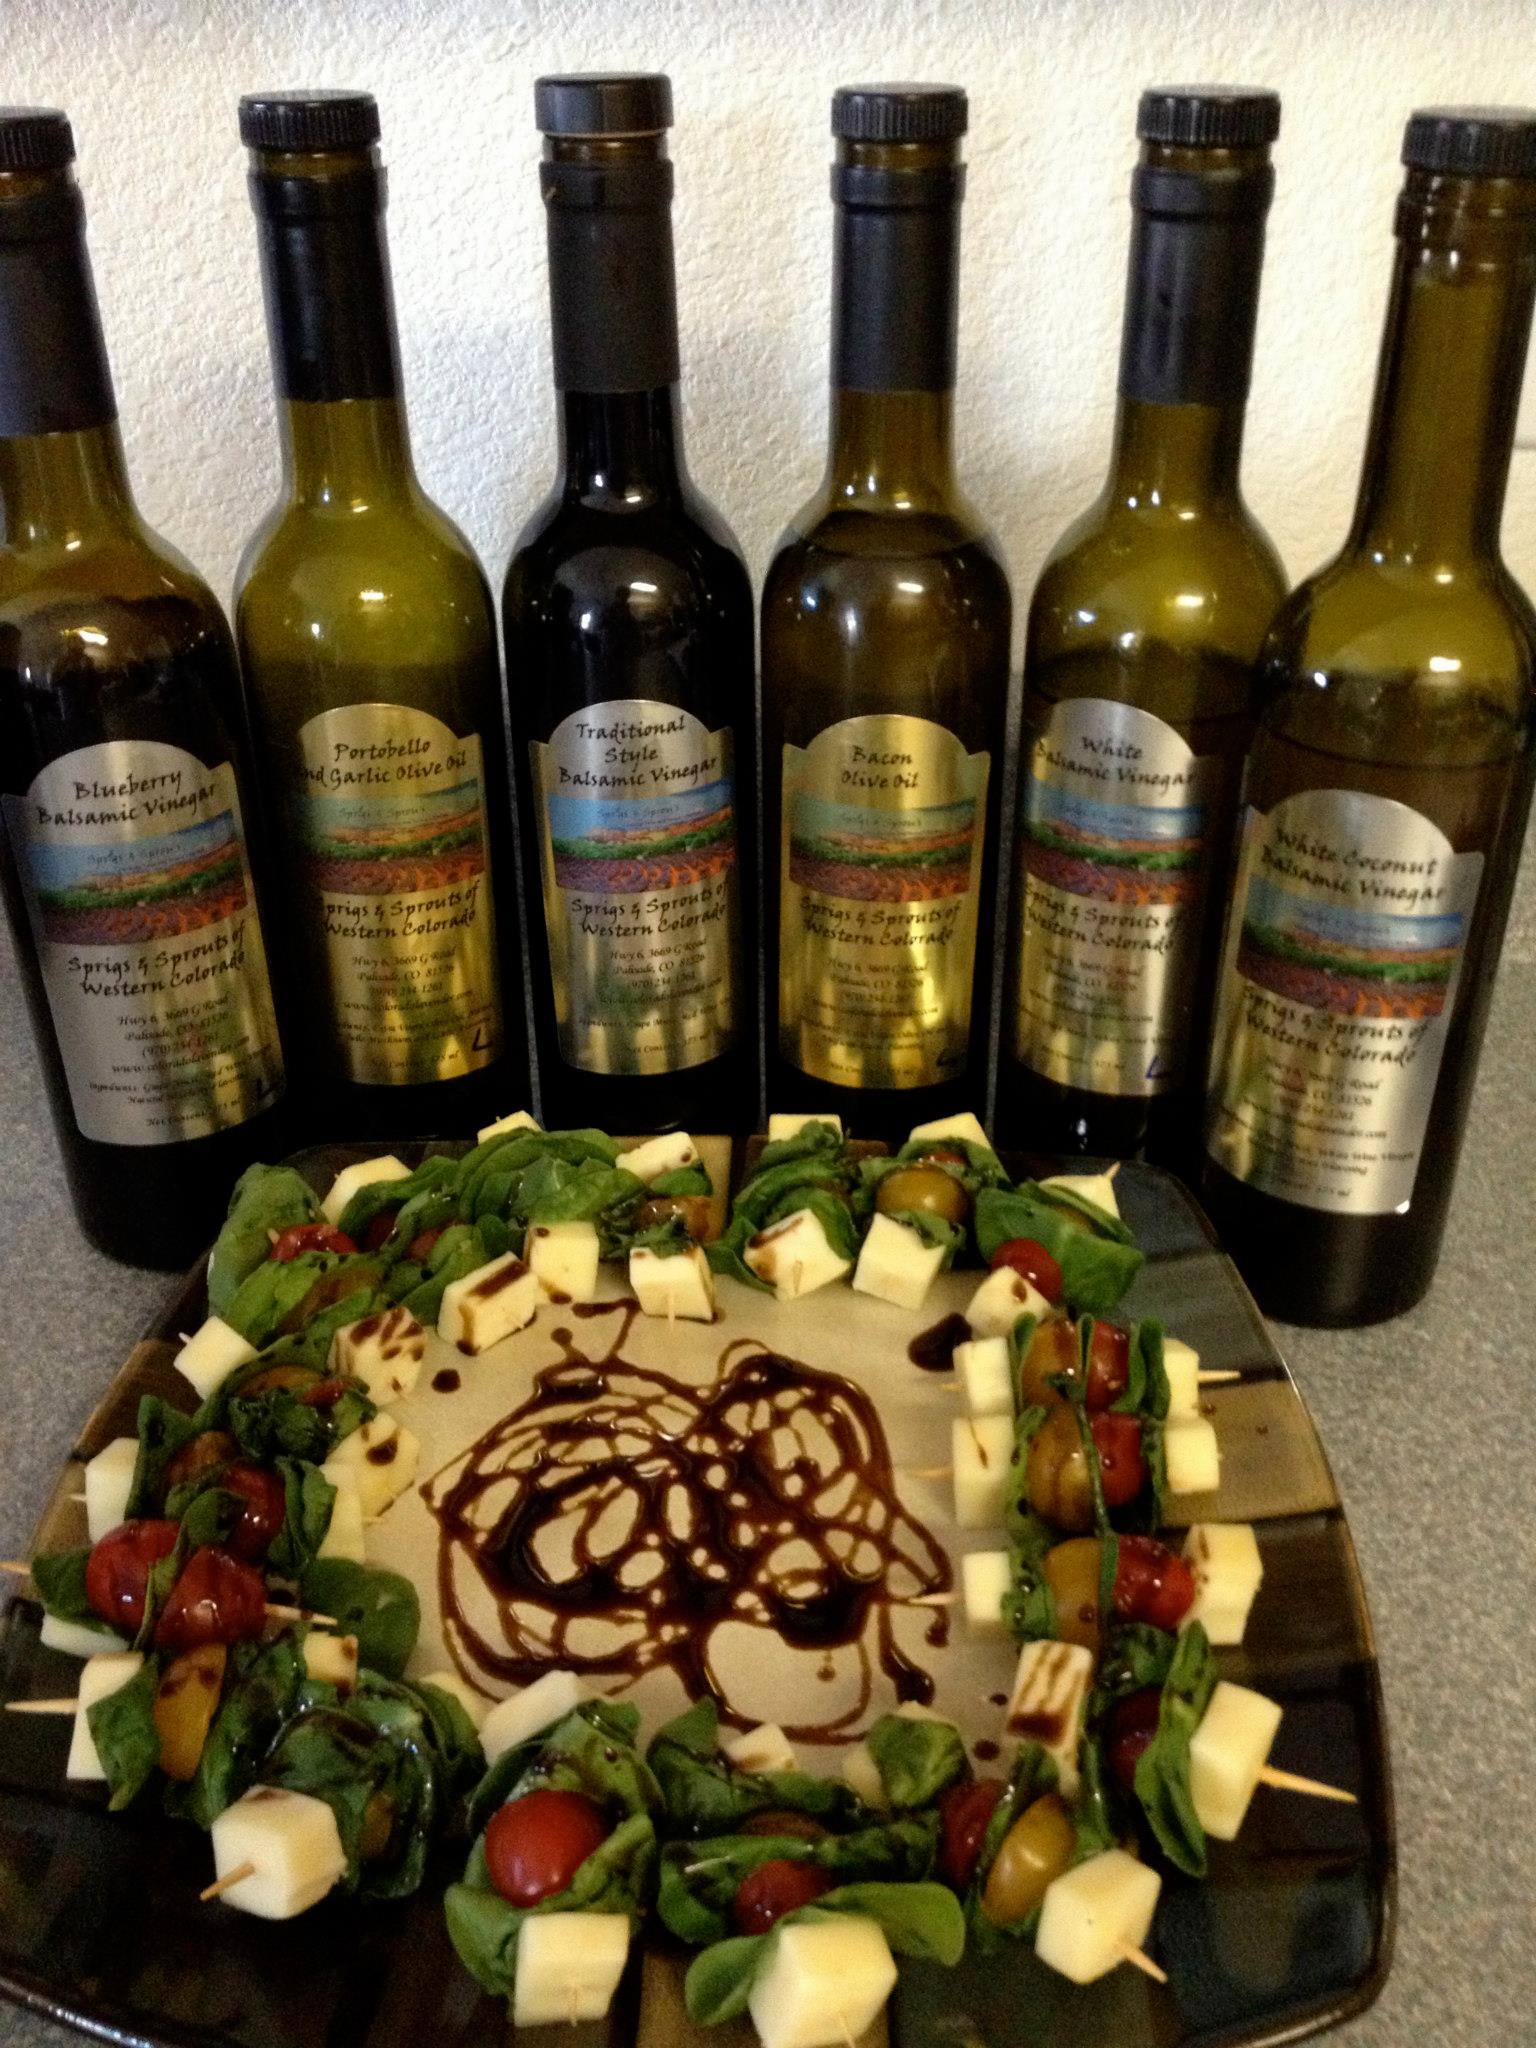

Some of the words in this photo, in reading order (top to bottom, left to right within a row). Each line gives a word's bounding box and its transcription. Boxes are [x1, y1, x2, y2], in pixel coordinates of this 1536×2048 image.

[576, 715, 685, 743] Traditional
[334, 738, 431, 762] Portobello
[604, 743, 658, 773] Style
[851, 744, 912, 765] Bacon
[1082, 736, 1143, 759] White
[73, 769, 181, 802] Blueberry
[302, 765, 327, 787] nd
[330, 765, 391, 790] Garlic
[395, 761, 442, 780] Olive
[446, 750, 467, 771] Oil
[558, 766, 646, 788] Balsamic
[650, 757, 716, 785] Vinegar
[841, 770, 889, 789] Olive
[893, 771, 919, 788] Oil
[37, 803, 140, 826] Balsamic
[143, 783, 216, 815] Vinegar
[1342, 849, 1437, 875] Coconut
[326, 901, 368, 926] prigs
[390, 892, 462, 924] Sprouts
[465, 879, 480, 908] of
[571, 898, 625, 924] Sprigs
[647, 887, 713, 920] Sprouts
[1360, 880, 1445, 910] Vinegar
[324, 922, 397, 939] Western
[402, 908, 476, 936] Colorado
[580, 920, 652, 938] Western
[658, 902, 727, 934] Colorado
[870, 909, 941, 934] Sprouts
[68, 956, 131, 984] Sprigs
[156, 933, 228, 975] Sprouts
[80, 981, 166, 998] Western
[170, 949, 246, 988] Colorado
